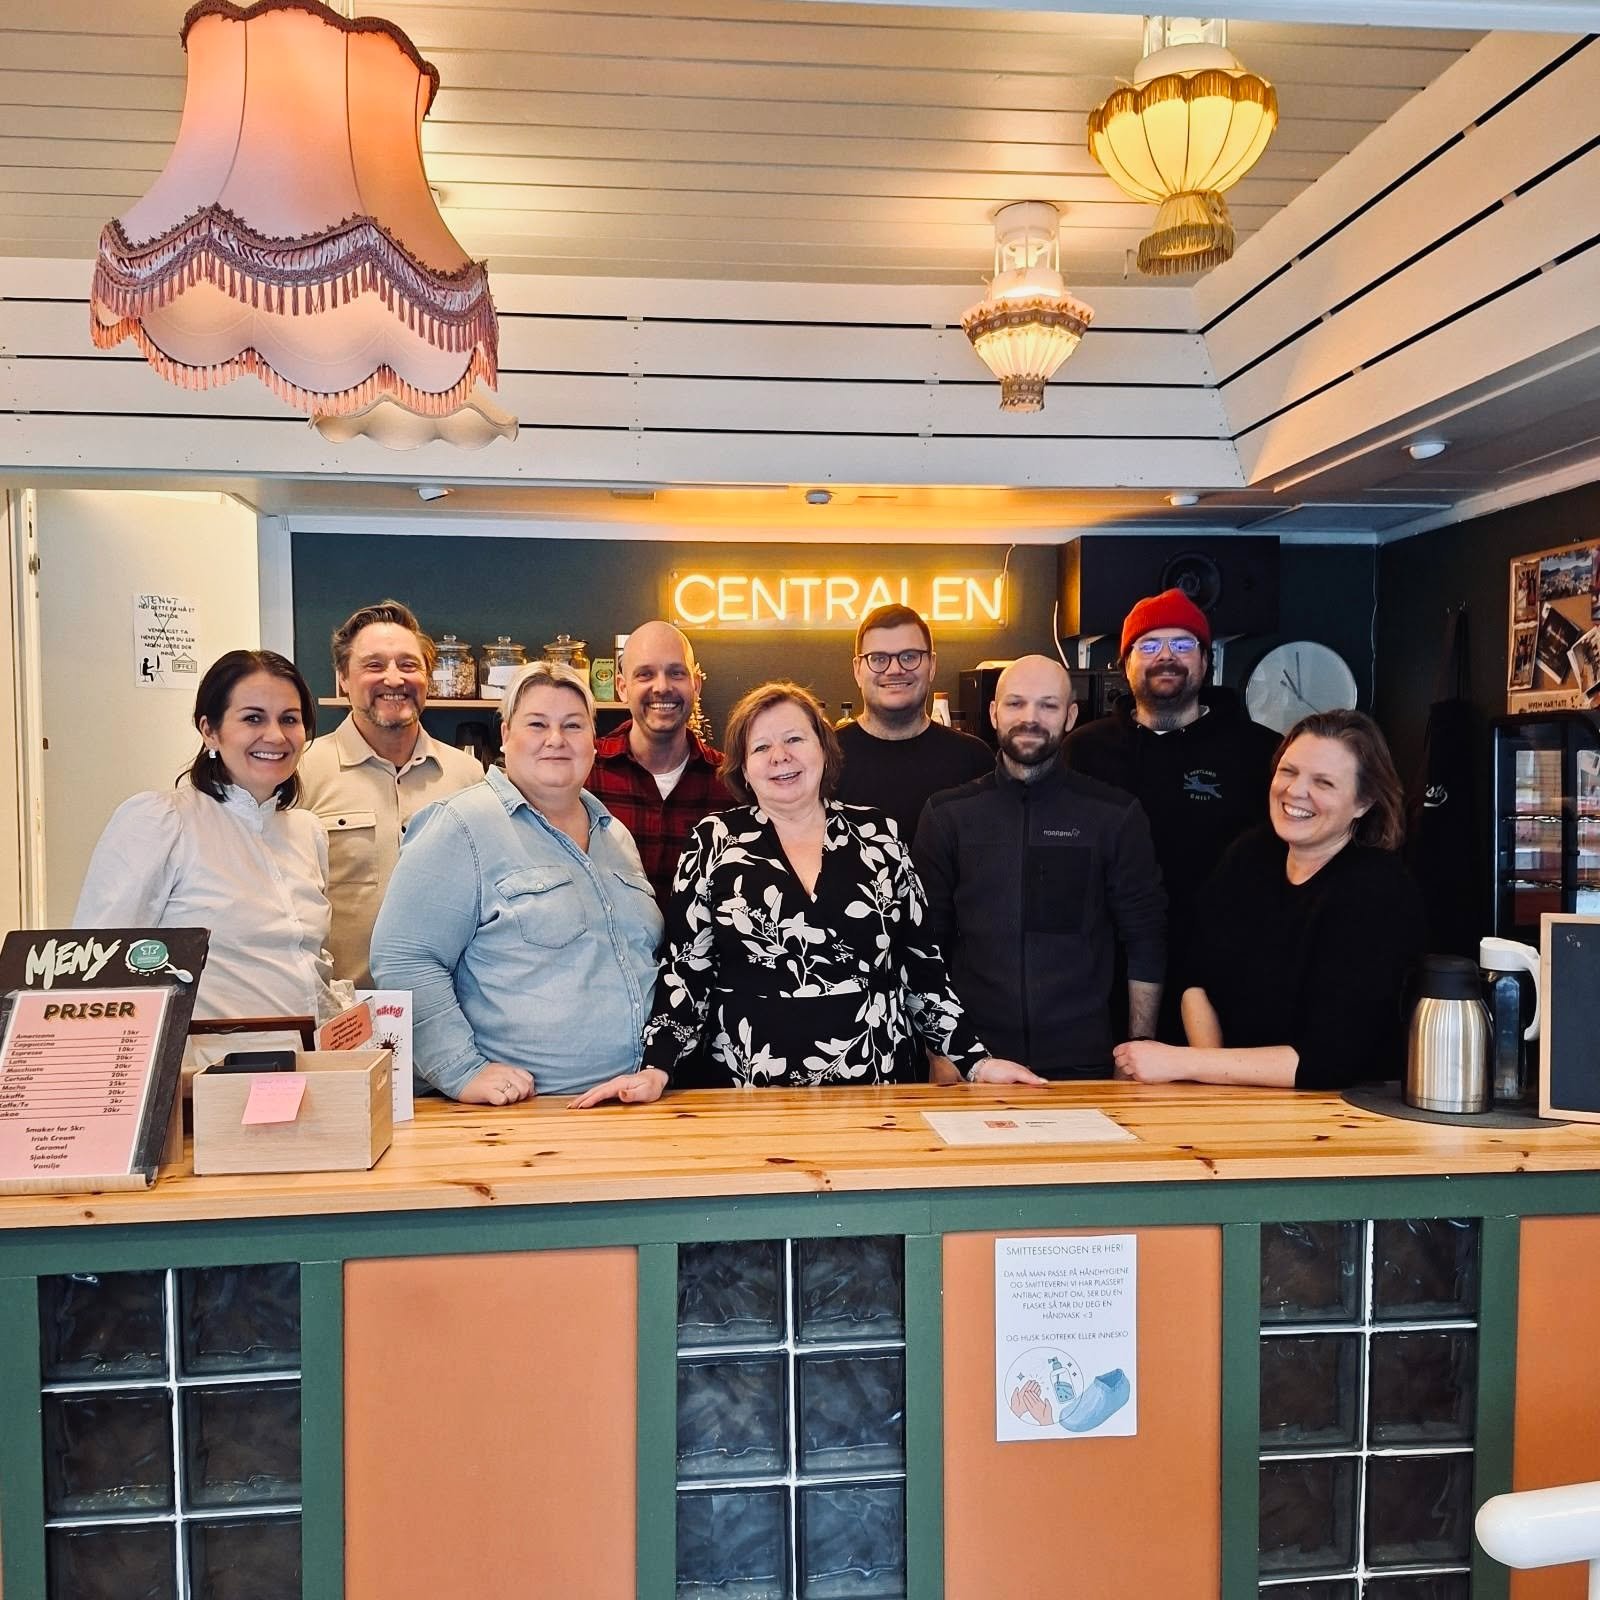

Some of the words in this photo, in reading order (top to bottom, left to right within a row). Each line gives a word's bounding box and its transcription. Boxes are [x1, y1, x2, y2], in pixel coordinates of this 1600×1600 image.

[674, 574, 1001, 623] CENTRALEN
[25, 937, 122, 990] MENY
[43, 1002, 136, 1021] PRISER
[1006, 1245, 1089, 1256] SMITTESESONGEN
[1092, 1244, 1102, 1254] ER
[1003, 1270, 1014, 1278] DA
[1048, 1269, 1066, 1277] PASSE
[1069, 1267, 1078, 1276] PÅ
[1079, 1279, 1093, 1287] HAR
[1094, 1278, 1124, 1286] PLASSERT
[1044, 1291, 1068, 1299] RUNDT
[1087, 1289, 1099, 1297] SER
[1101, 1289, 1111, 1297] DU
[1113, 1288, 1123, 1296] EN
[1023, 1302, 1046, 1310] FLASKE
[1059, 1301, 1071, 1309] TAR
[1072, 1301, 1084, 1309] DU
[1086, 1300, 1101, 1308] DEG
[1103, 1299, 1112, 1308] EN
[1042, 1311, 1080, 1320] HÅNDVASK
[1006, 1334, 1019, 1342] OG
[1021, 1333, 1040, 1342] HUSK
